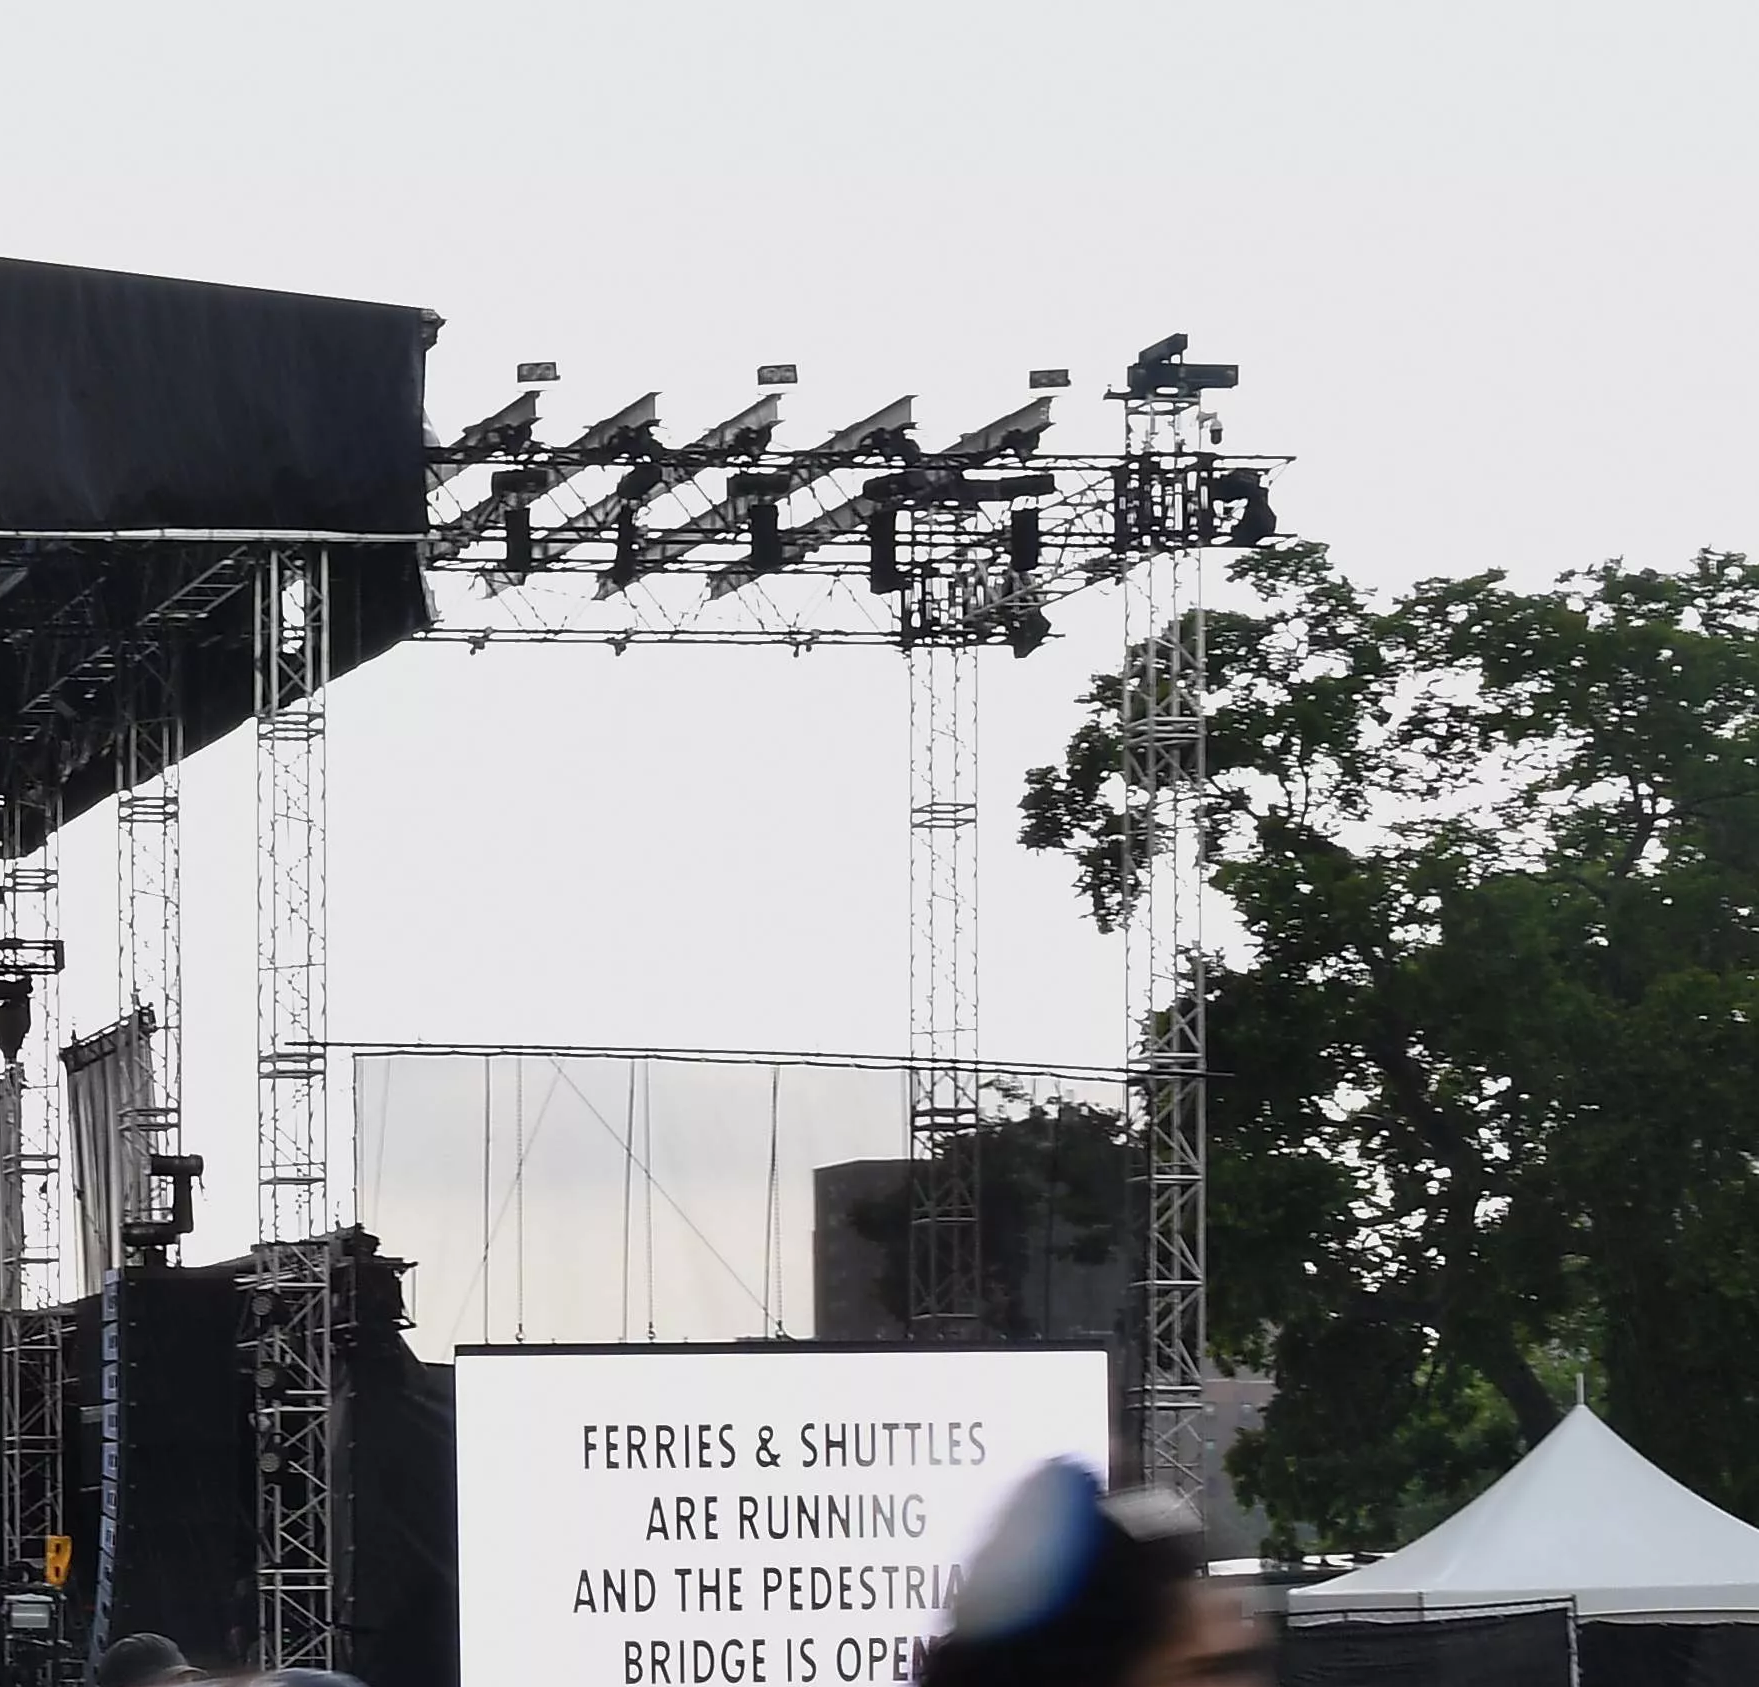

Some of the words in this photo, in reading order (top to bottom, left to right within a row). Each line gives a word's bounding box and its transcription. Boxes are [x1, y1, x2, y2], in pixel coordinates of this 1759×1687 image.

[584, 1424, 736, 1469] FERRIES
[756, 1425, 781, 1467] &
[801, 1422, 985, 1467] SHUTTLES
[646, 1496, 718, 1541] ARE
[739, 1494, 926, 1540] RUNNING
[573, 1569, 656, 1613] AND
[675, 1568, 743, 1612] THE
[763, 1564, 968, 1613] PEDESTRIA
[625, 1639, 766, 1684] BRIDGE
[787, 1638, 816, 1682] IS
